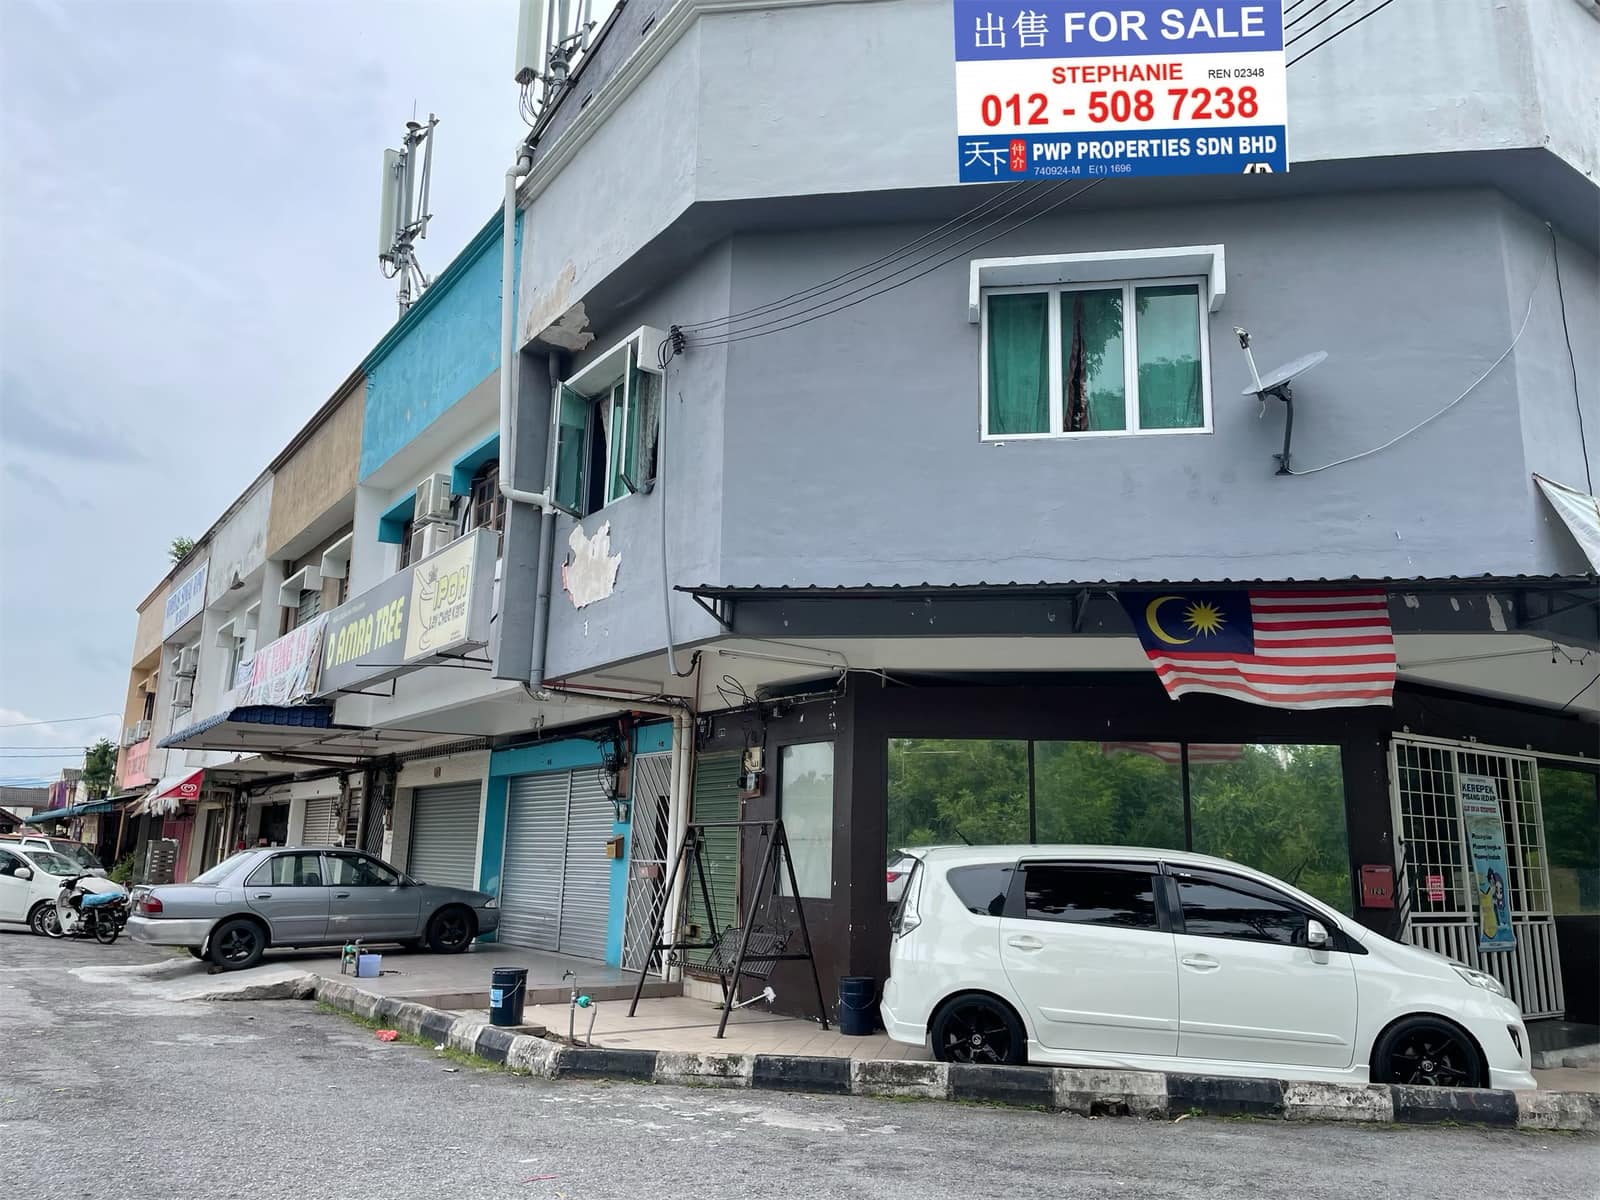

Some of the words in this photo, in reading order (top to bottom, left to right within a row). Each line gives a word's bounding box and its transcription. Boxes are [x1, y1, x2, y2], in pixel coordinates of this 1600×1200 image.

[974, 9, 1050, 49] 出售
[1063, 10, 1148, 43] FOR
[1160, 6, 1266, 40] SALE
[1051, 63, 1183, 85] STEPHANIE
[1208, 69, 1232, 79] REN
[1233, 67, 1265, 79] 02348
[981, 93, 1049, 127] 012
[1087, 90, 1155, 123] 508
[1167, 86, 1259, 121] 7238
[1032, 142, 1072, 161] PWP
[1077, 137, 1191, 160] PROPERTIES
[1196, 136, 1233, 156] SDN
[1239, 135, 1277, 155] BHD
[1033, 165, 1081, 176] 740924-M
[1088, 164, 1108, 175] E(1)
[1110, 163, 1132, 174] 1696
[432, 564, 469, 611] IPOH
[374, 595, 405, 650] TREE
[1462, 783, 1495, 795] KEREPEK
